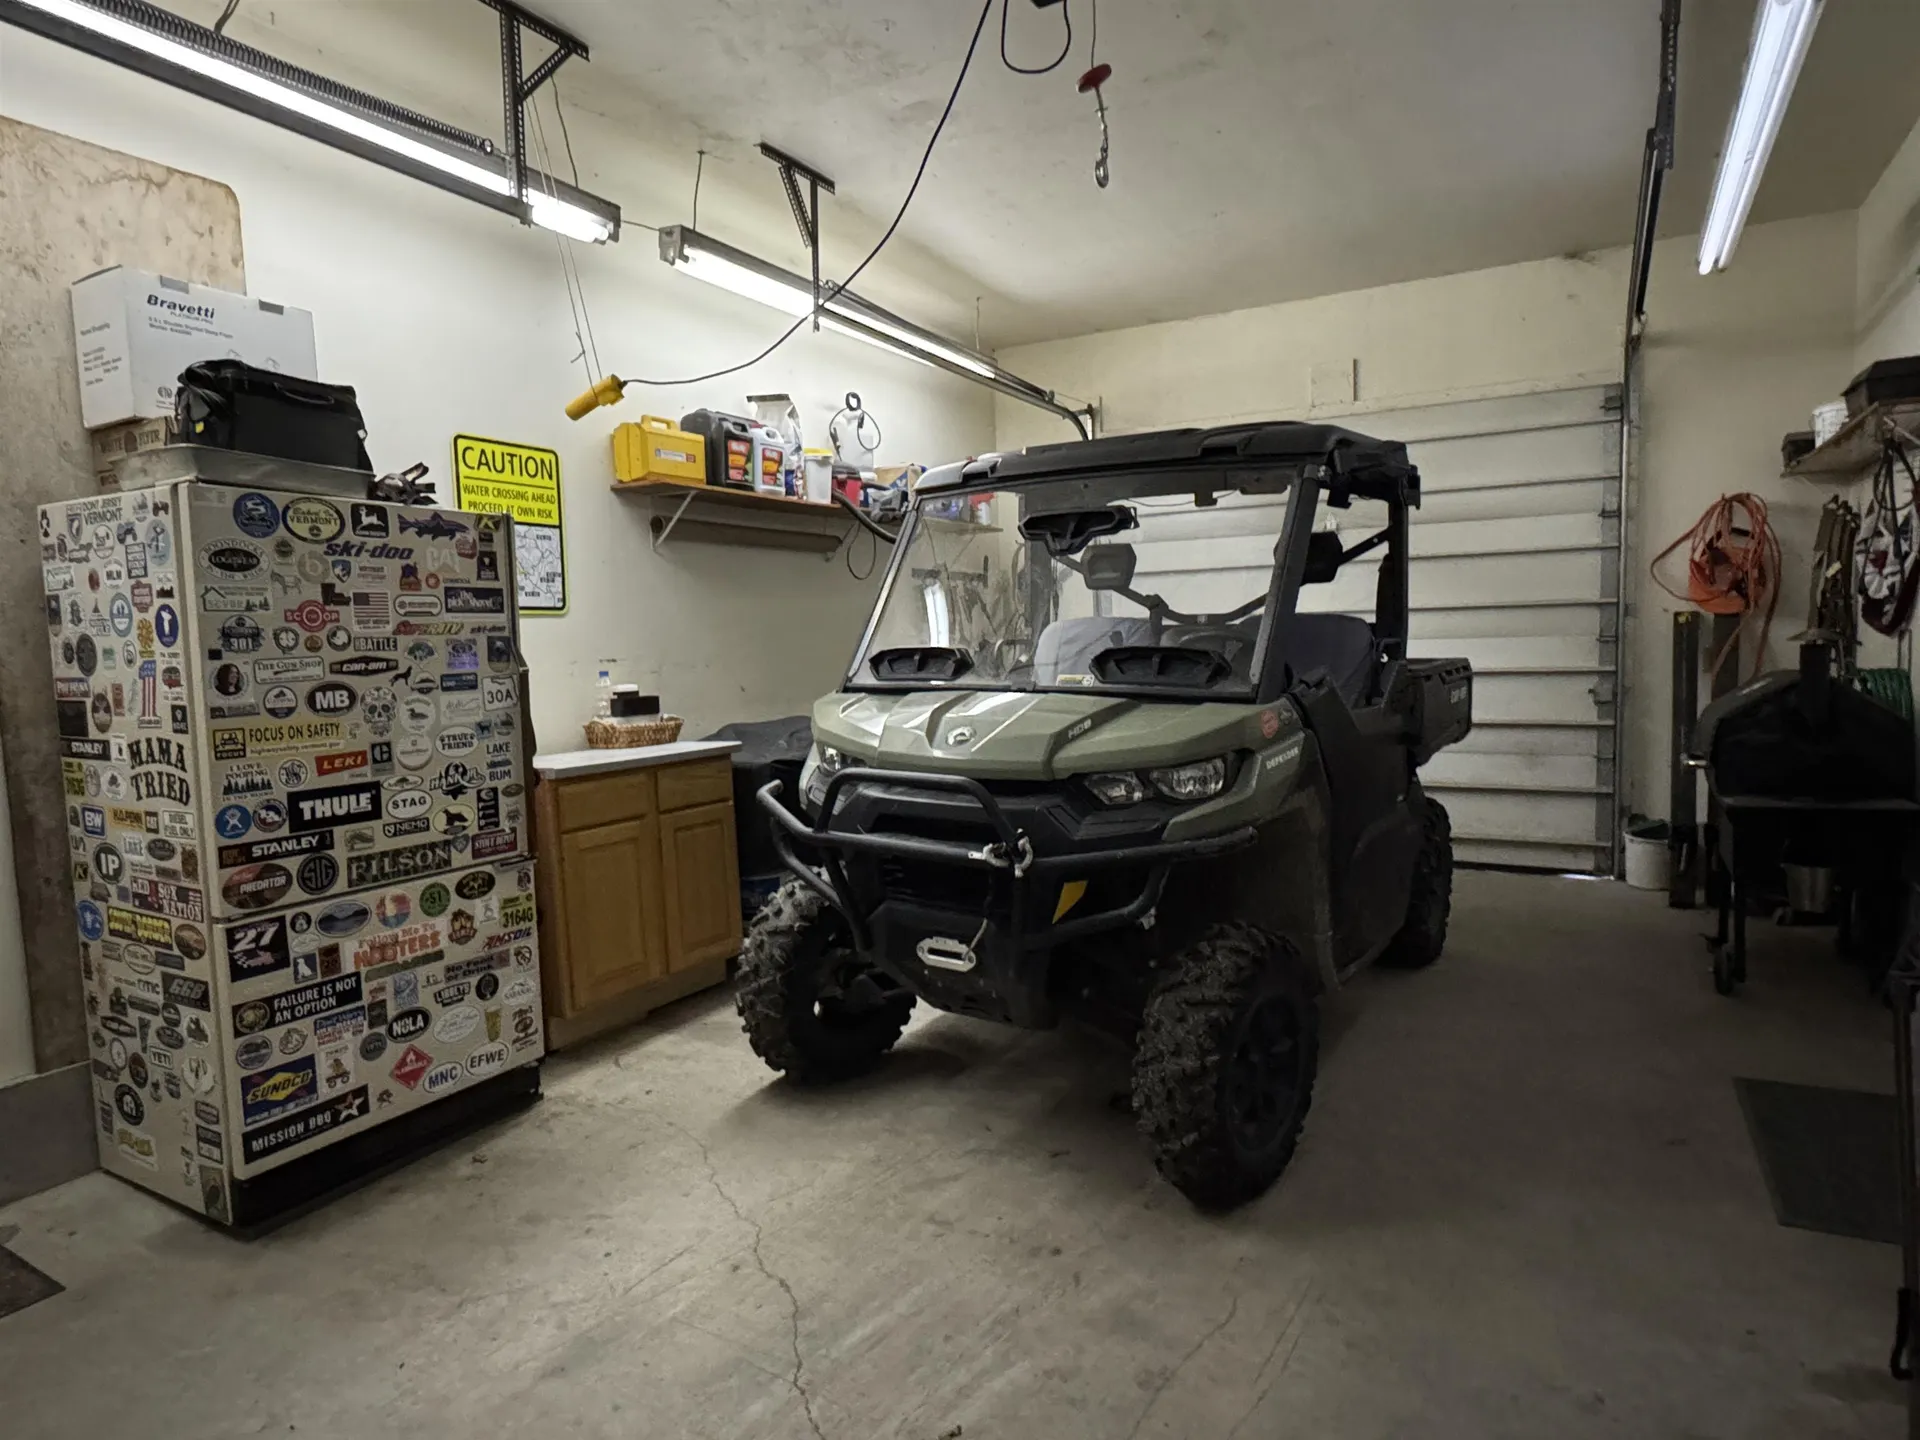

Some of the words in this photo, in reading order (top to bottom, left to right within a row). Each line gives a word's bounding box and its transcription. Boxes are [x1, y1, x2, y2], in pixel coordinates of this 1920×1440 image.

[147, 294, 215, 319] Bravetti
[462, 446, 553, 481] CAUTION
[462, 483, 490, 498] WATER
[491, 487, 529, 503] CROSSING
[531, 491, 556, 505] AHEAD
[83, 508, 123, 525] VERMONT
[289, 514, 339, 526] VERMONT
[468, 501, 504, 515] PROCEED
[506, 505, 515, 514] AT
[516, 507, 536, 518] OWN
[537, 508, 554, 519] RISK
[323, 539, 415, 560] ski-doo
[360, 637, 396, 650] BATTLE
[342, 660, 387, 671] can-am
[315, 690, 350, 709] MB
[486, 689, 514, 705] 30A
[249, 727, 284, 742] FOCUS
[288, 727, 304, 739] ON
[307, 722, 340, 738] SAFETY
[444, 733, 469, 742] TRUE
[71, 741, 103, 754] STANLEY
[127, 737, 188, 773] MAMA
[441, 742, 474, 751] FRIEND
[486, 742, 511, 755] LAKE
[322, 755, 362, 770] LEKI
[225, 769, 268, 781] POOPING
[489, 769, 512, 781] BUM
[130, 771, 191, 806] TRIED
[298, 792, 373, 821] THULE
[391, 796, 427, 810] STAG
[84, 811, 103, 829] BW
[396, 818, 428, 833] NEMO
[251, 835, 320, 857] STANLEY
[100, 852, 120, 876] IP
[351, 846, 449, 878] FILSON
[303, 858, 334, 889] SIG
[157, 882, 178, 901] SOX
[239, 875, 287, 895] PREDATOR
[162, 899, 202, 921] NATION
[502, 906, 534, 928] 3164G
[234, 921, 280, 952] 27
[273, 986, 321, 1011] FAILURE
[322, 983, 333, 996] IS
[335, 976, 358, 992] NOT
[275, 1010, 292, 1024] AN
[294, 996, 337, 1017] OPTION
[392, 1014, 424, 1037] NOLA
[152, 1051, 171, 1065] YETI
[470, 1048, 505, 1069] EFWE
[250, 1071, 312, 1101] SUNOCO
[428, 1066, 458, 1089] MNC
[251, 1122, 305, 1152] MISSION
[309, 1110, 332, 1129] BBQ
